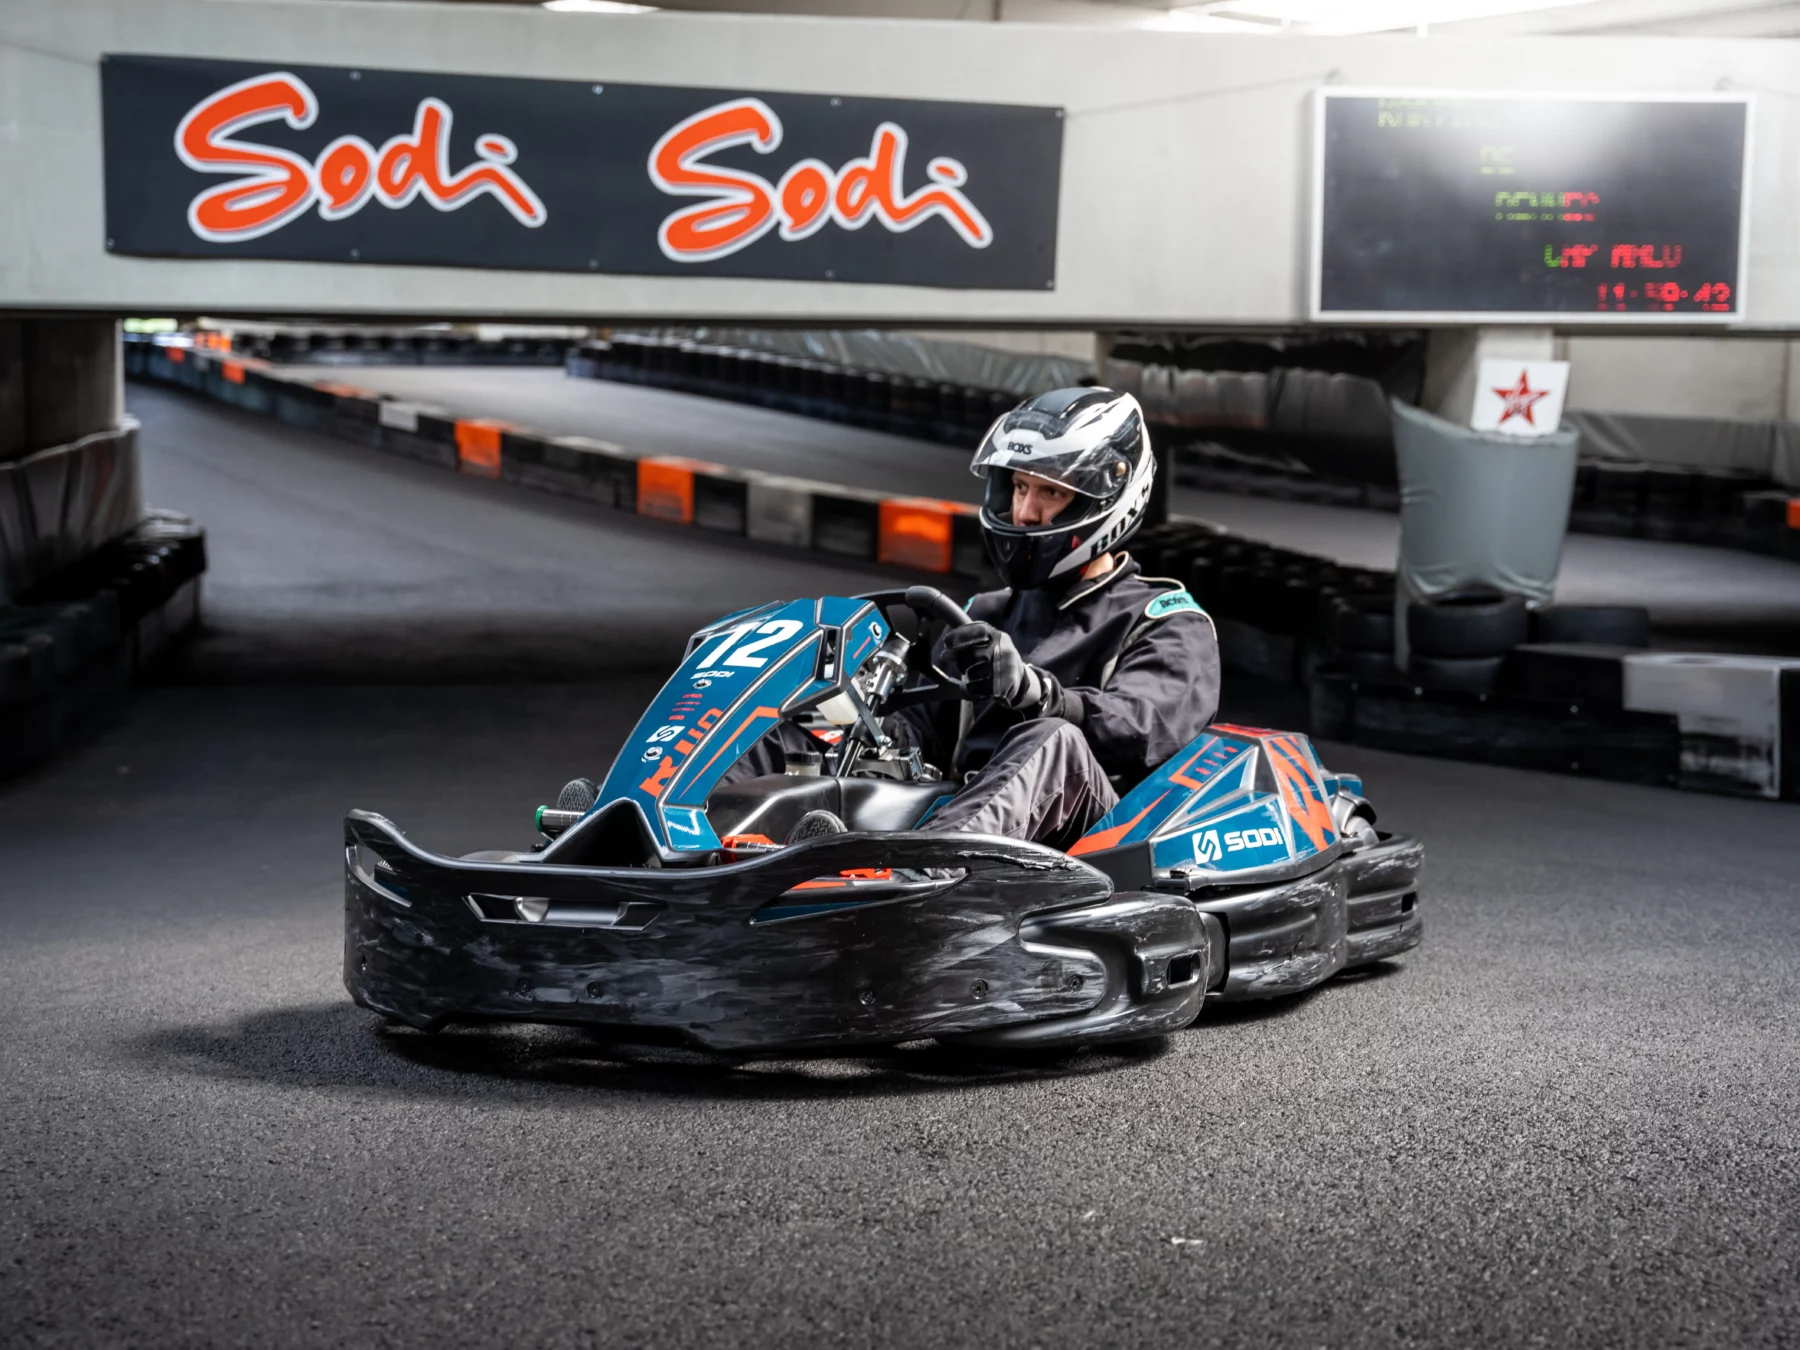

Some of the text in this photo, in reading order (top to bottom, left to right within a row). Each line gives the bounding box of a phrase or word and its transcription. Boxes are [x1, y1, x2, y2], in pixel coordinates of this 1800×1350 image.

[174, 72, 993, 262] Sodi Sodi
[1007, 441, 1033, 455] BOXS
[696, 619, 804, 669] 12
[690, 670, 736, 680] SODI
[1224, 827, 1284, 853] SODI
